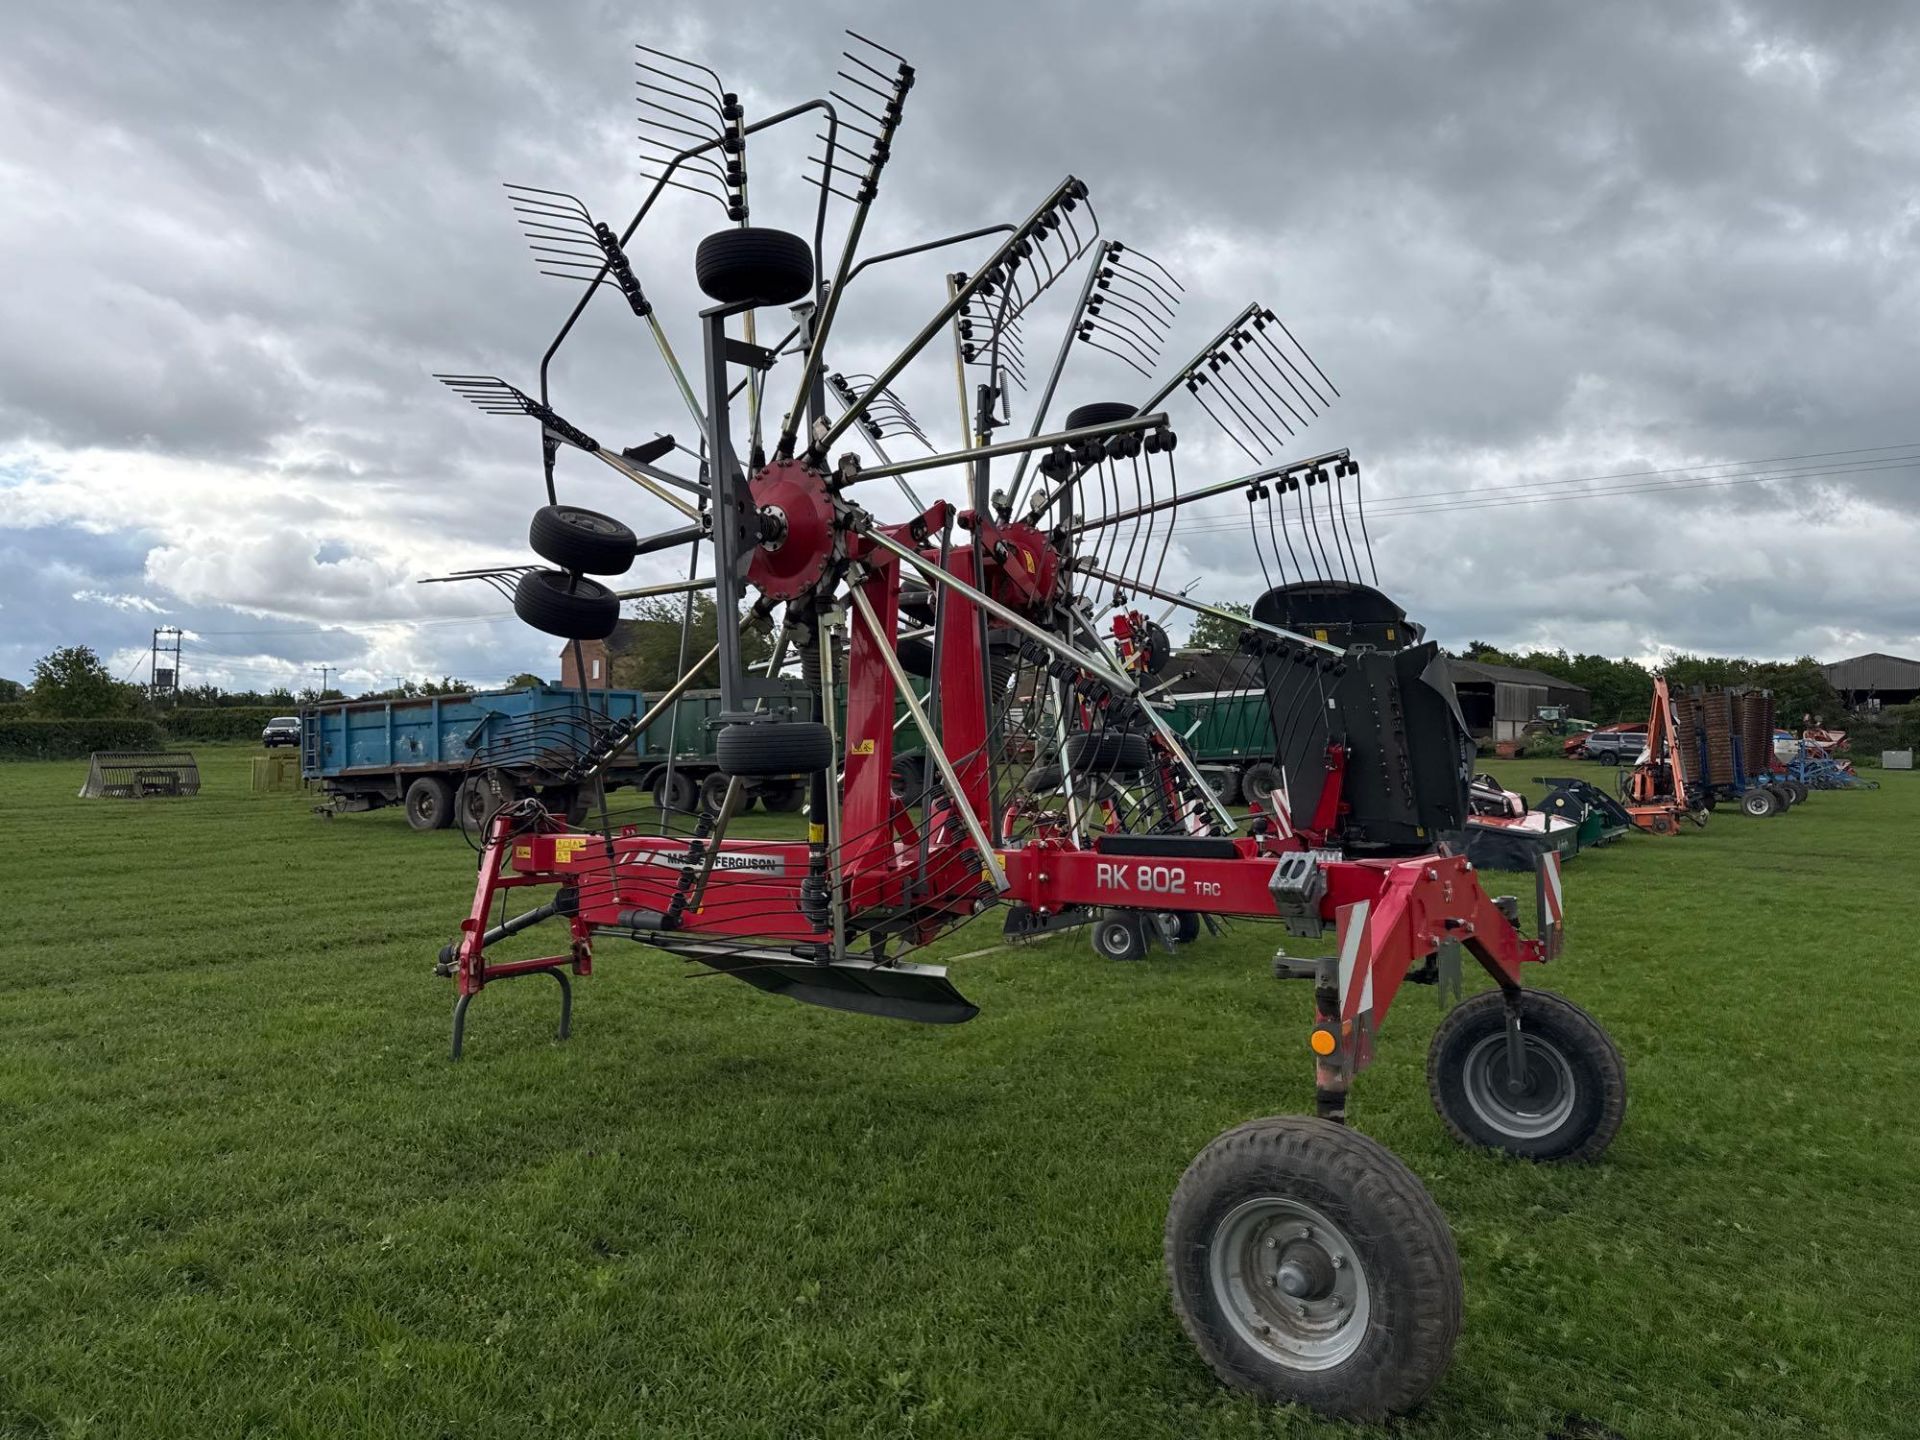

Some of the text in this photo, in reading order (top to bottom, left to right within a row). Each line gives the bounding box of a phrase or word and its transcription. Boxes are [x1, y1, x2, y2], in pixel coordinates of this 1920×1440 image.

[714, 856, 776, 871] FERGUSON
[1097, 863, 1221, 896] RK 802 TRC
